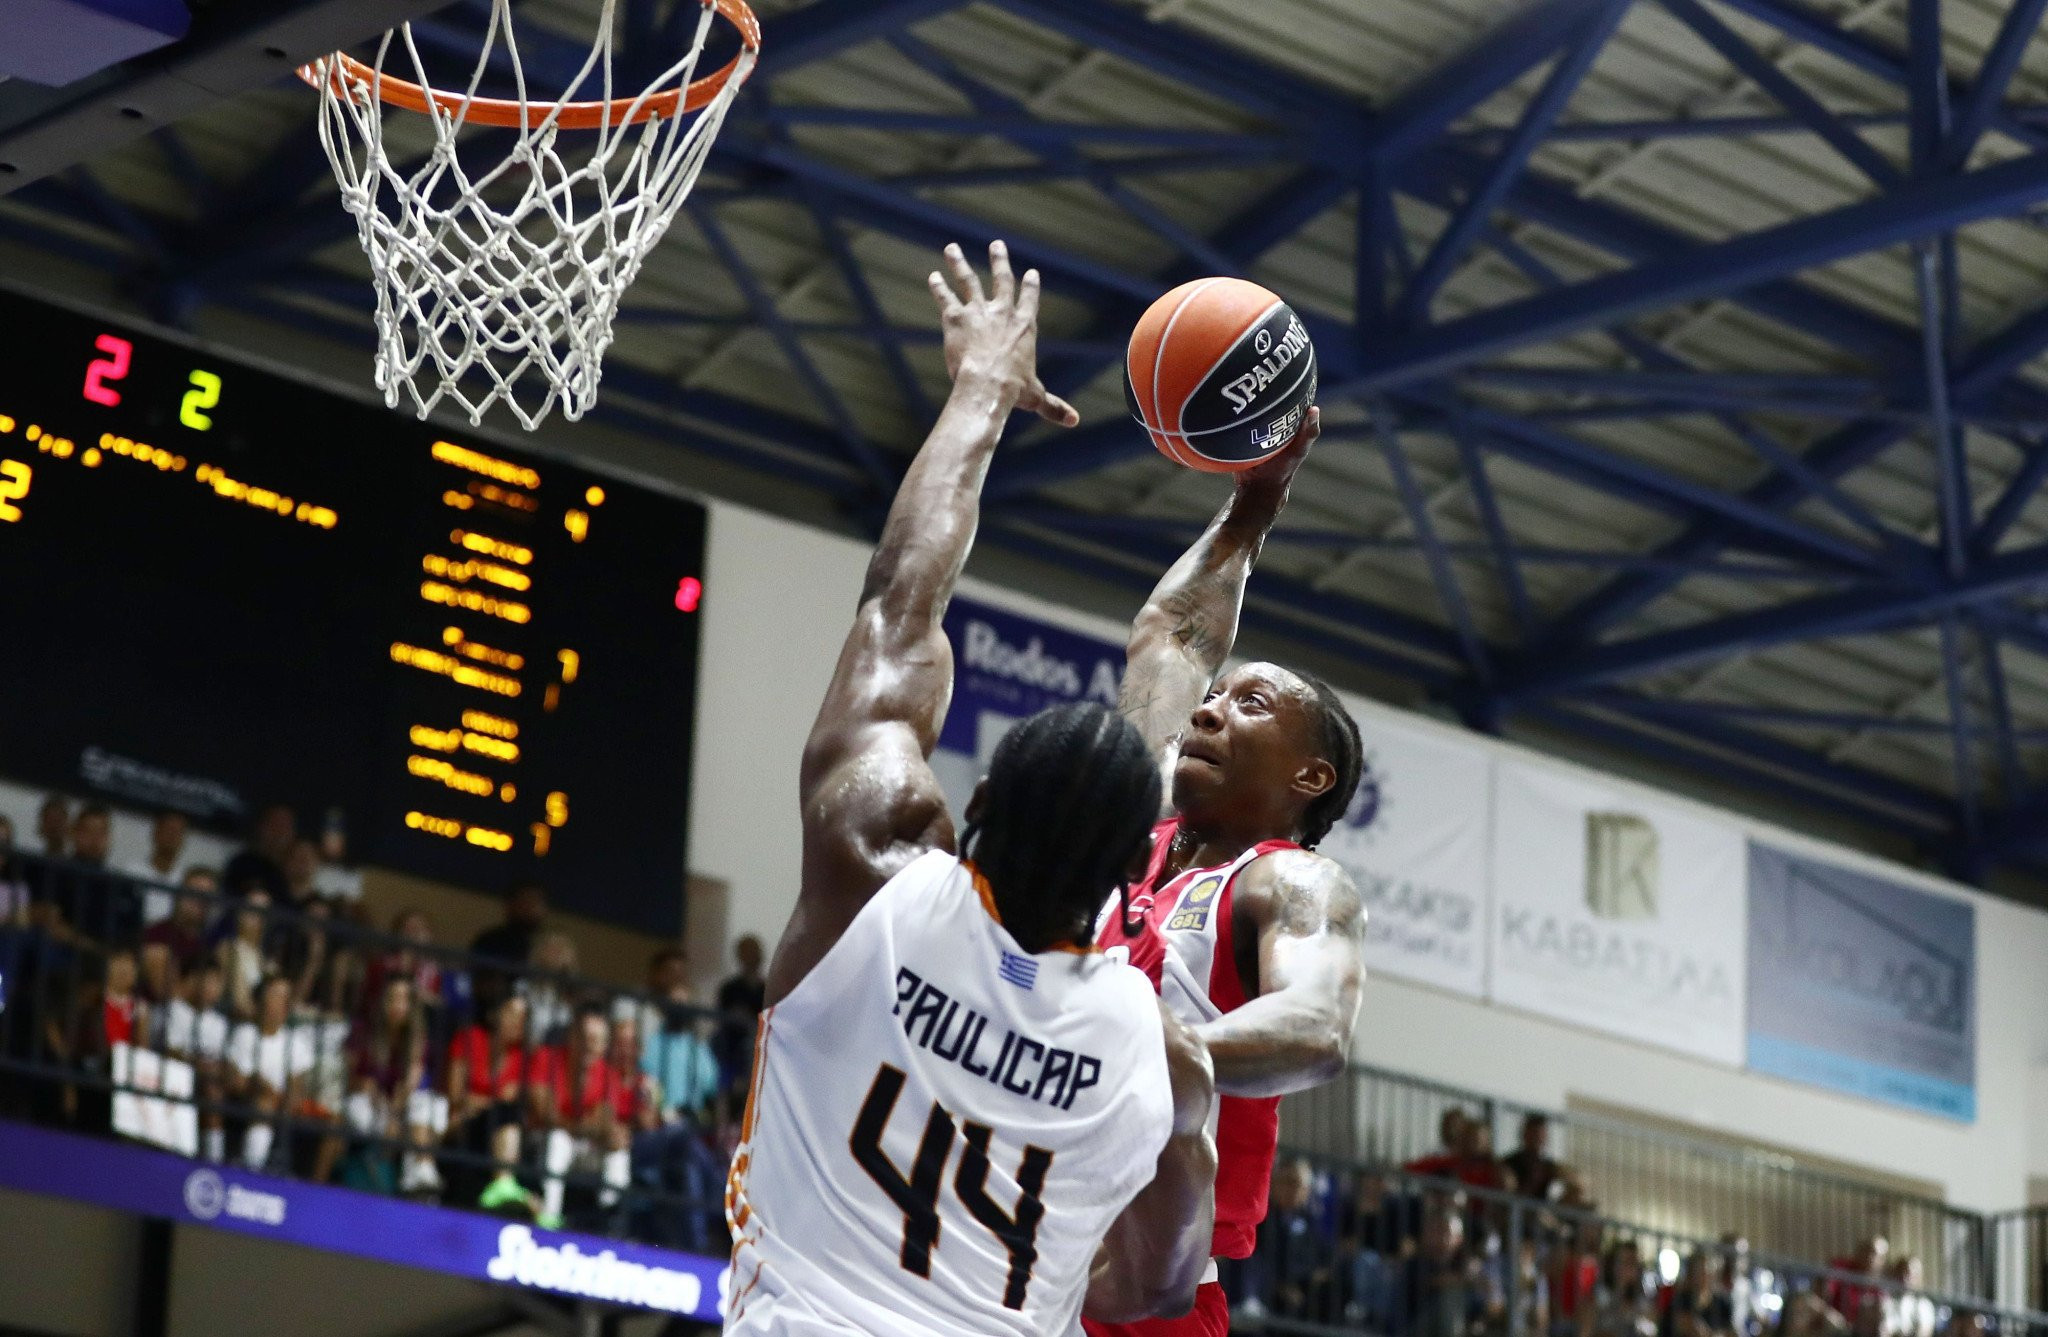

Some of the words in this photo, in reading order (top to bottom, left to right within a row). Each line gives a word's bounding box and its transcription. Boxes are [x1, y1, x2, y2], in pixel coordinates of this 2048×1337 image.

[83, 333, 133, 408] 2
[180, 369, 222, 432] 2
[1170, 913, 1203, 929] GBL
[892, 965, 1102, 1111] PAULICAP
[849, 1062, 1055, 1312] 44
